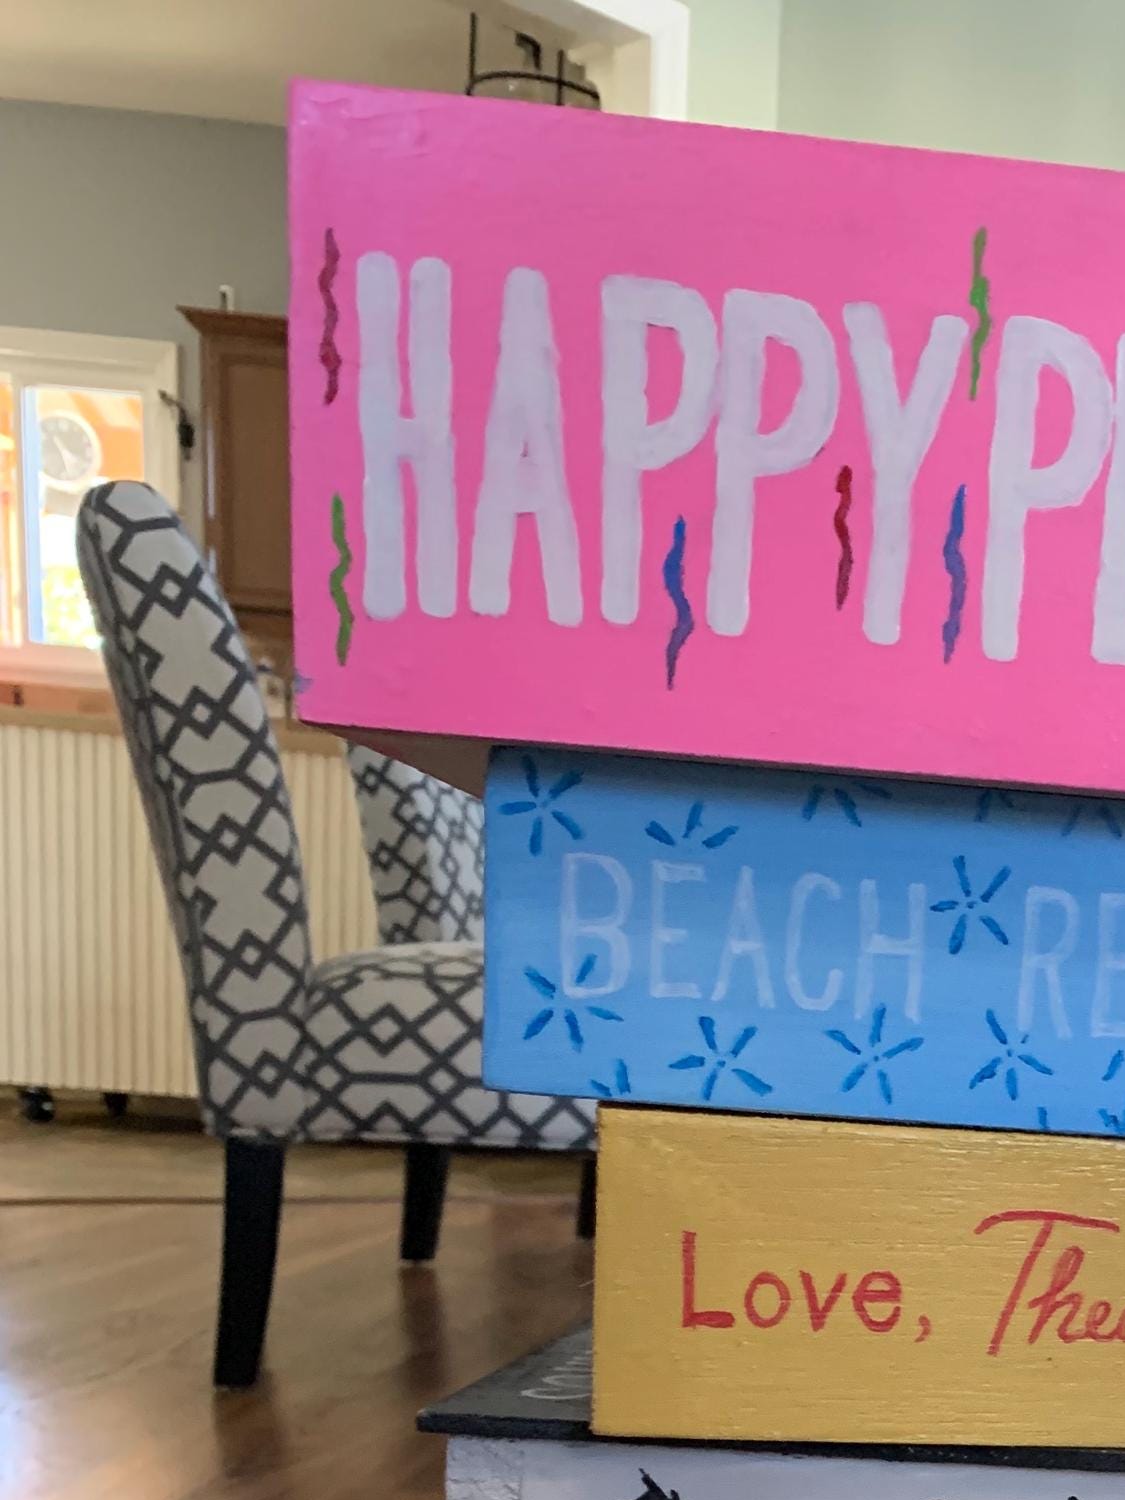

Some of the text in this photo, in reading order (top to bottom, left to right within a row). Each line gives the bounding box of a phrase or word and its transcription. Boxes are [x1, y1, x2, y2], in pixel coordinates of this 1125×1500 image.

[356, 250, 971, 646] HAPPY
[560, 851, 928, 1024] BEACH
[681, 1229, 933, 1344] Love,
